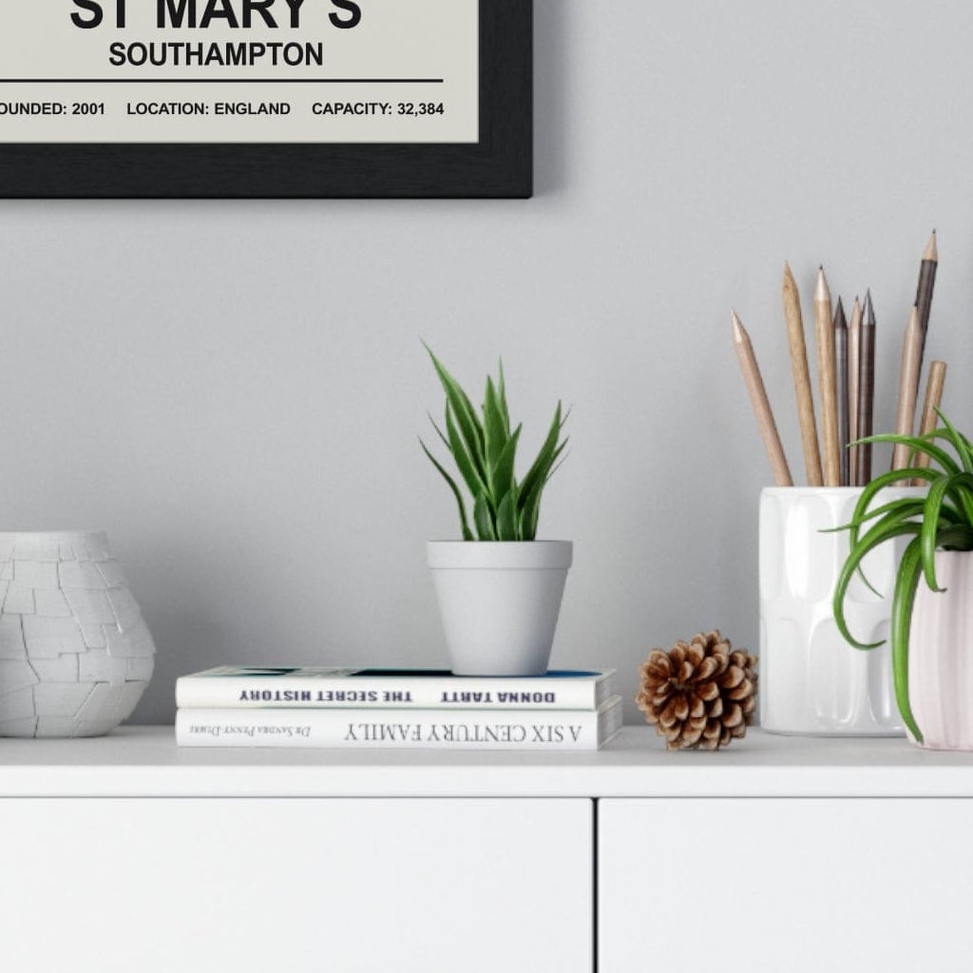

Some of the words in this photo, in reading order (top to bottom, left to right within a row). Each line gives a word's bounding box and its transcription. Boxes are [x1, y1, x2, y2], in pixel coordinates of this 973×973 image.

[108, 41, 323, 67] SOUTHAMPTON
[72, 102, 105, 115] 2001
[126, 102, 209, 115] LOCATION:
[214, 102, 291, 115] ENGLAND
[311, 102, 392, 115] CAPACITY:
[397, 102, 445, 117] 32,384
[239, 690, 311, 701] HISTORY
[316, 690, 378, 702] SECRET
[384, 690, 413, 702] THE
[440, 690, 493, 703] TARTT
[497, 691, 556, 703] DONNA
[344, 723, 422, 741] FAMILY
[427, 724, 527, 742] CENTURY
[531, 725, 565, 742] SIX
[569, 725, 583, 742] A
